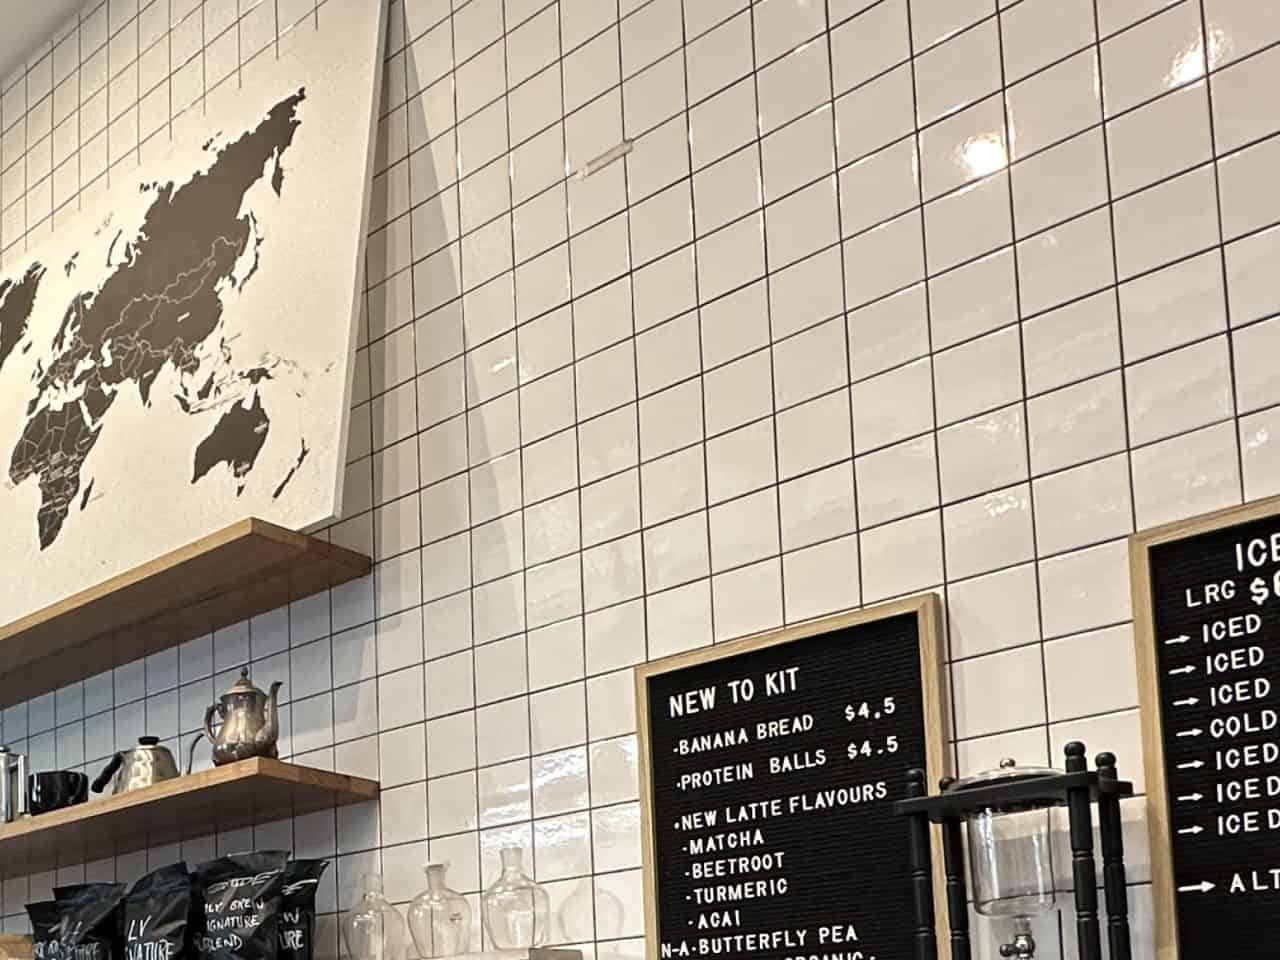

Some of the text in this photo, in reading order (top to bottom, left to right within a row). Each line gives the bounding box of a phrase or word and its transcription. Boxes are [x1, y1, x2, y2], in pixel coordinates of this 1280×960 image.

[1185, 579, 1236, 608] LRG
[1202, 613, 1262, 644] ICED
[1206, 646, 1265, 675] ICED
[669, 667, 800, 718] NEW TO KIT
[1210, 677, 1271, 707] ICED
[756, 714, 814, 741] BREAD
[844, 697, 895, 722] $4.5
[1209, 709, 1278, 739] COLD
[769, 749, 826, 775] BALLS
[847, 735, 899, 760] $4.5
[1216, 742, 1279, 771] ICED
[725, 800, 783, 824] LATTE
[788, 781, 888, 812] FLAVOURS
[1217, 775, 1280, 803] ICED
[1218, 808, 1280, 836] ICED
[818, 925, 858, 944] PEA
